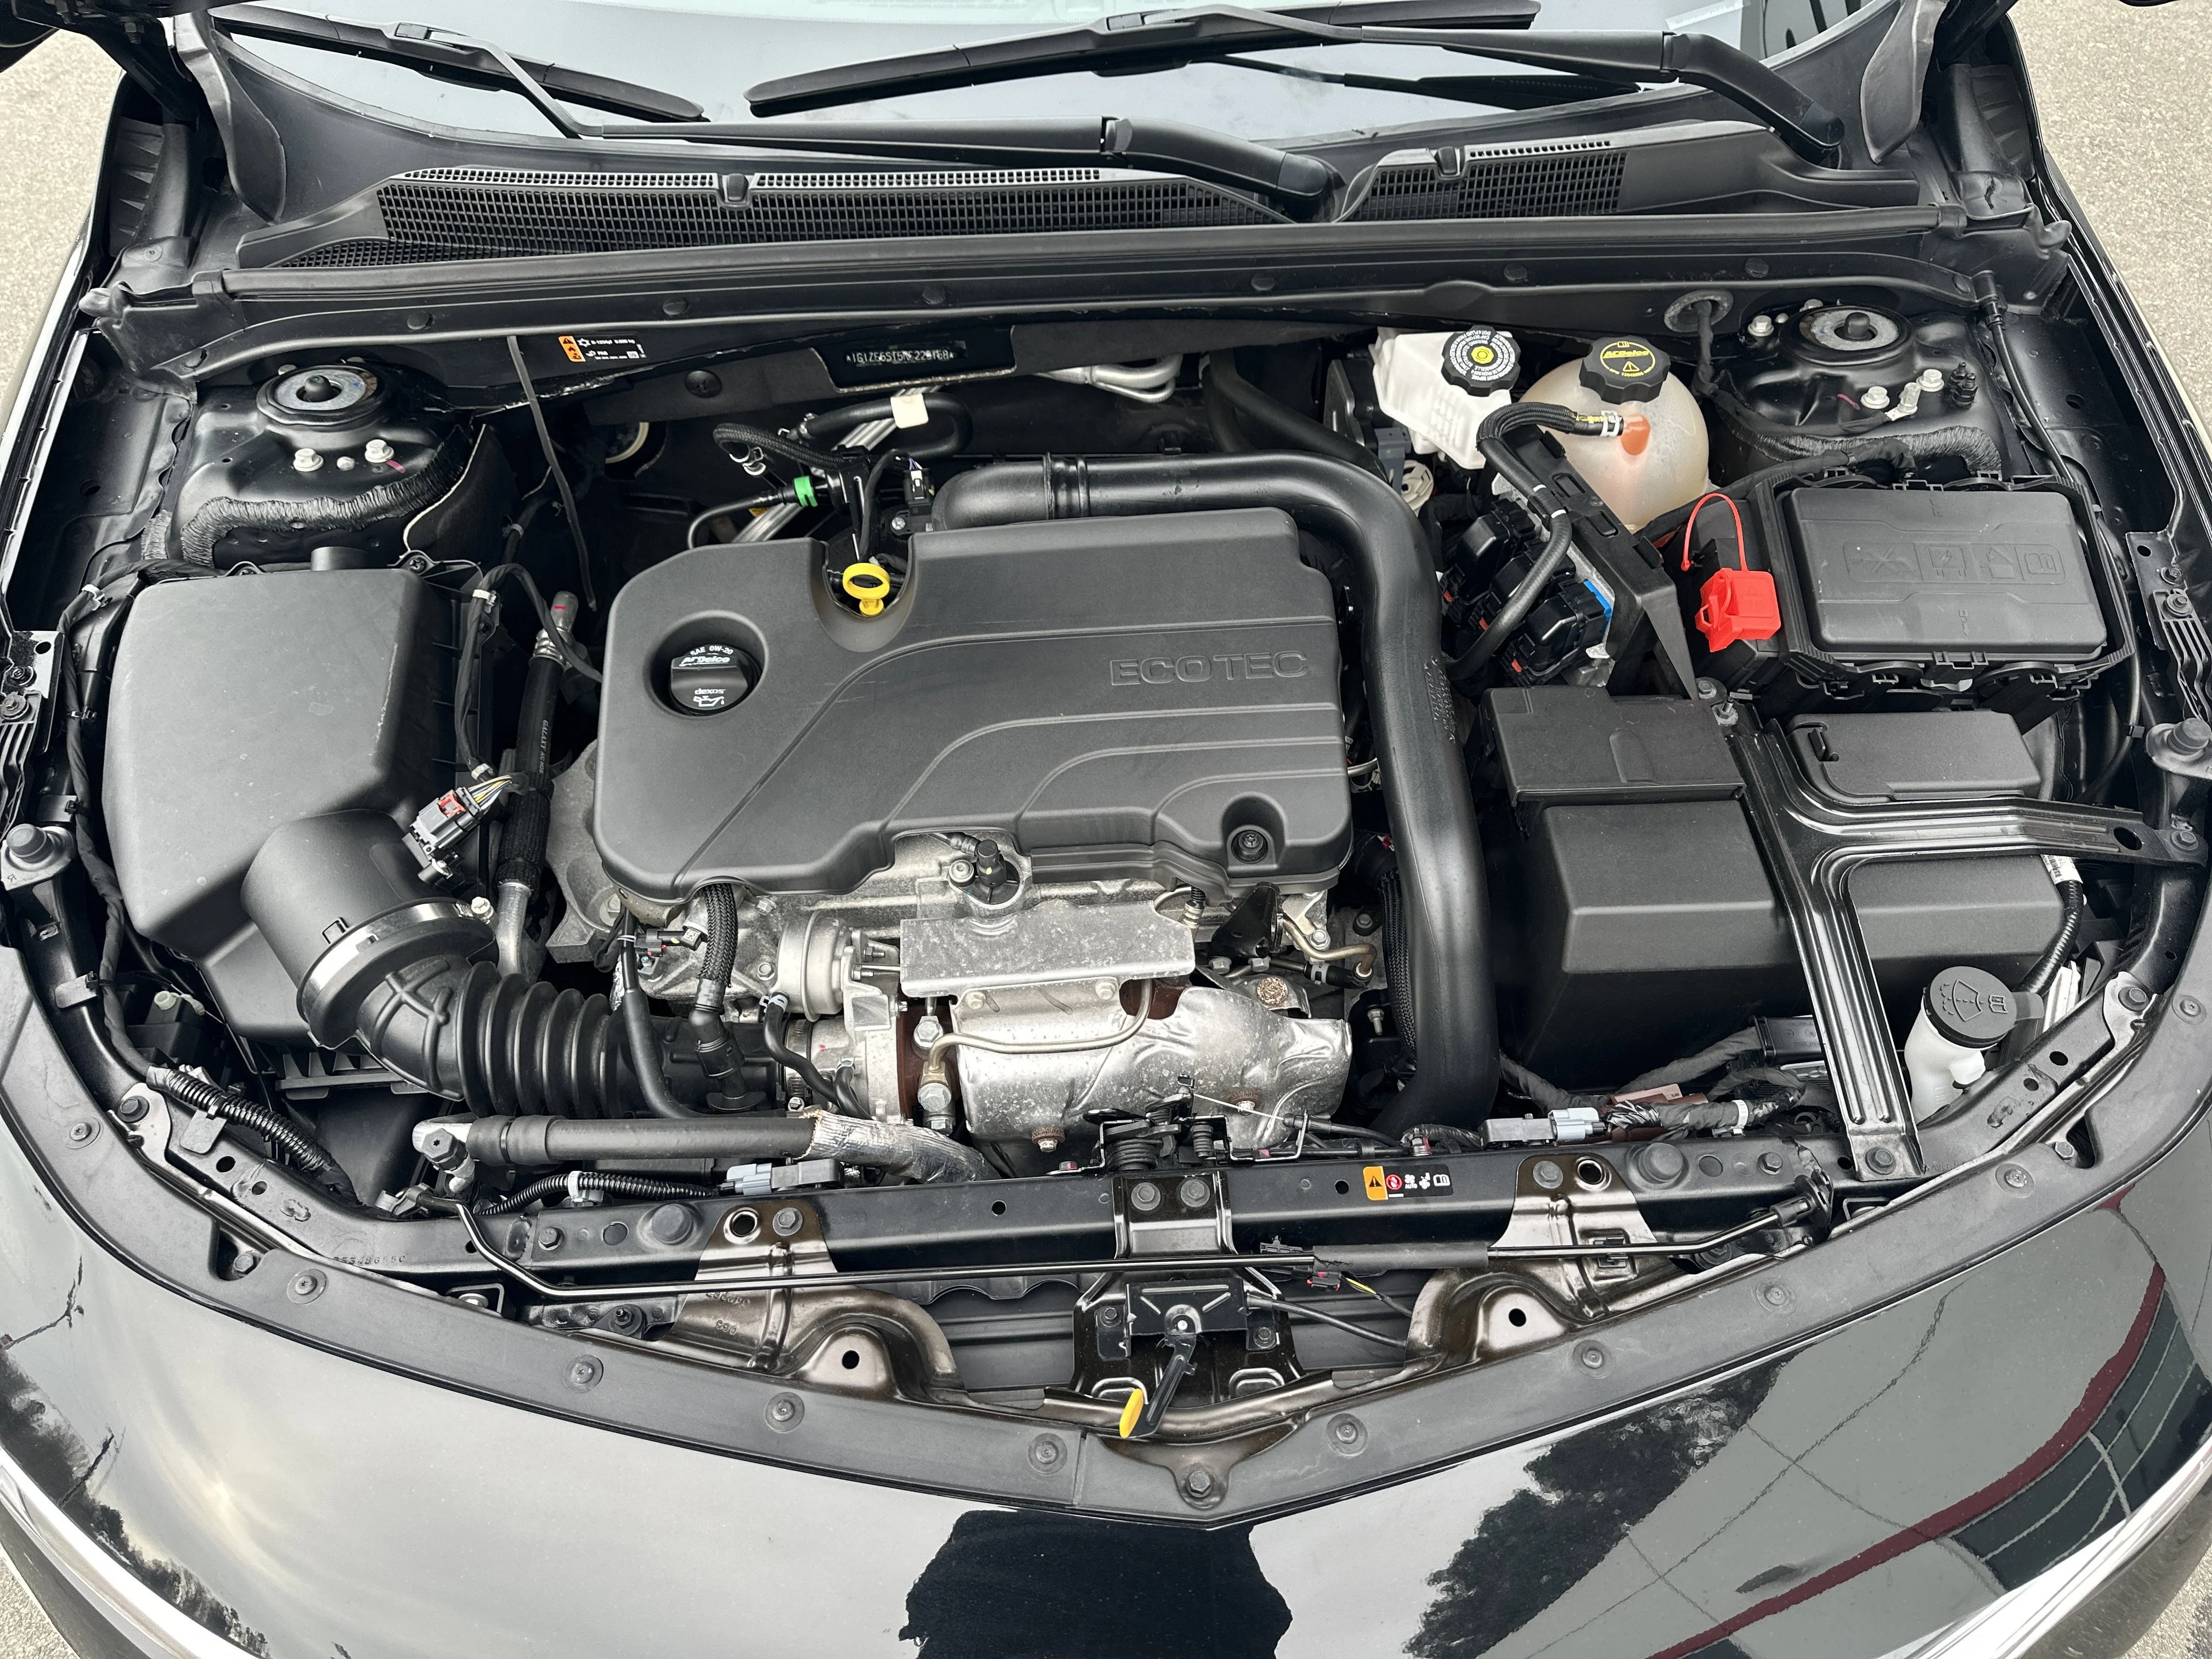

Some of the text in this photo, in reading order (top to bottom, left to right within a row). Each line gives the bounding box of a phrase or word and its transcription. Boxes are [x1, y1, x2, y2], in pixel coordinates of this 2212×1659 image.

[690, 645, 733, 656] SAE 0W-20
[1110, 651, 1308, 685] ECOTEC
